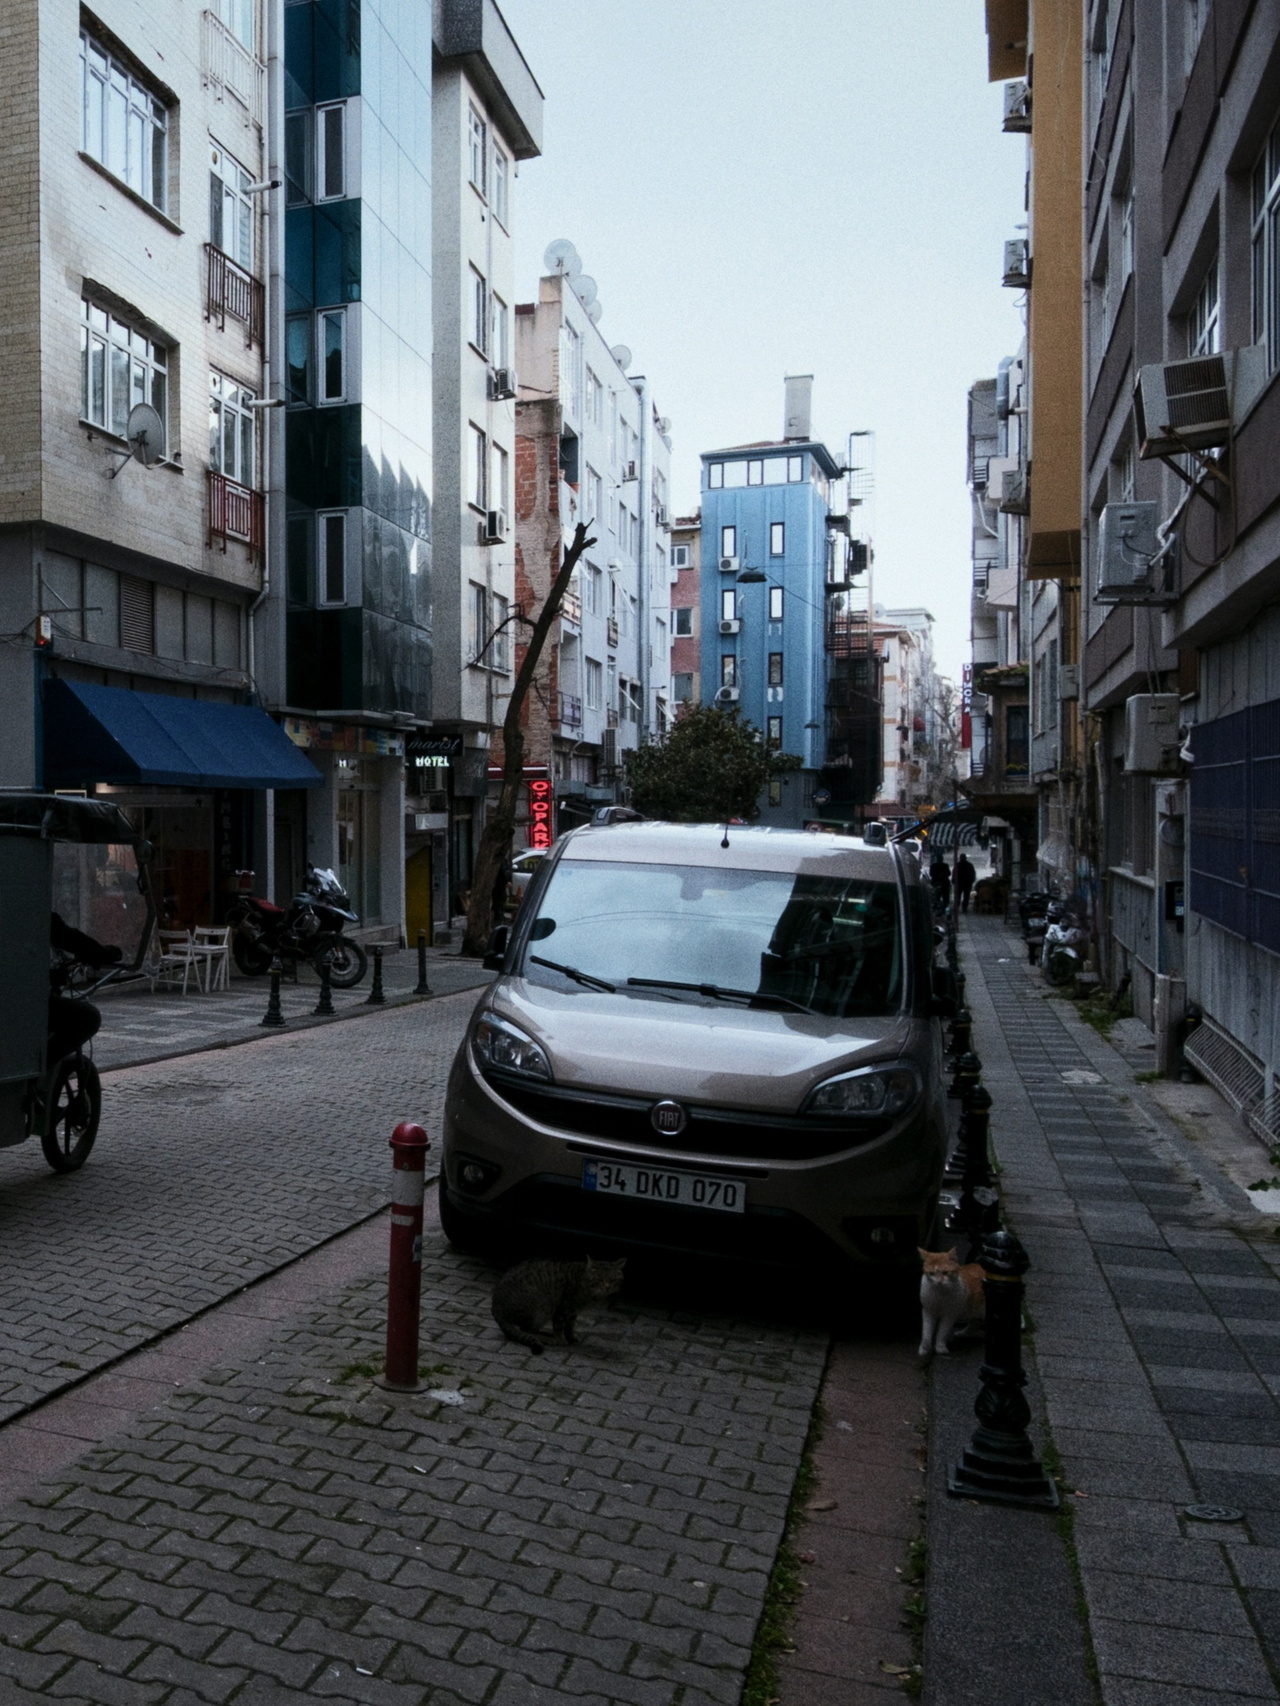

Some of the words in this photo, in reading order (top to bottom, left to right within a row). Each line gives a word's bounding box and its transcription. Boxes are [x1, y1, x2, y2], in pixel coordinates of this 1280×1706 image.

[415, 755, 450, 767] HOTEL
[531, 781, 549, 849] OTOPARK
[659, 1111, 679, 1128] FIAT
[599, 1166, 626, 1191] 34
[637, 1171, 679, 1199] DKD
[693, 1179, 737, 1207] 070
